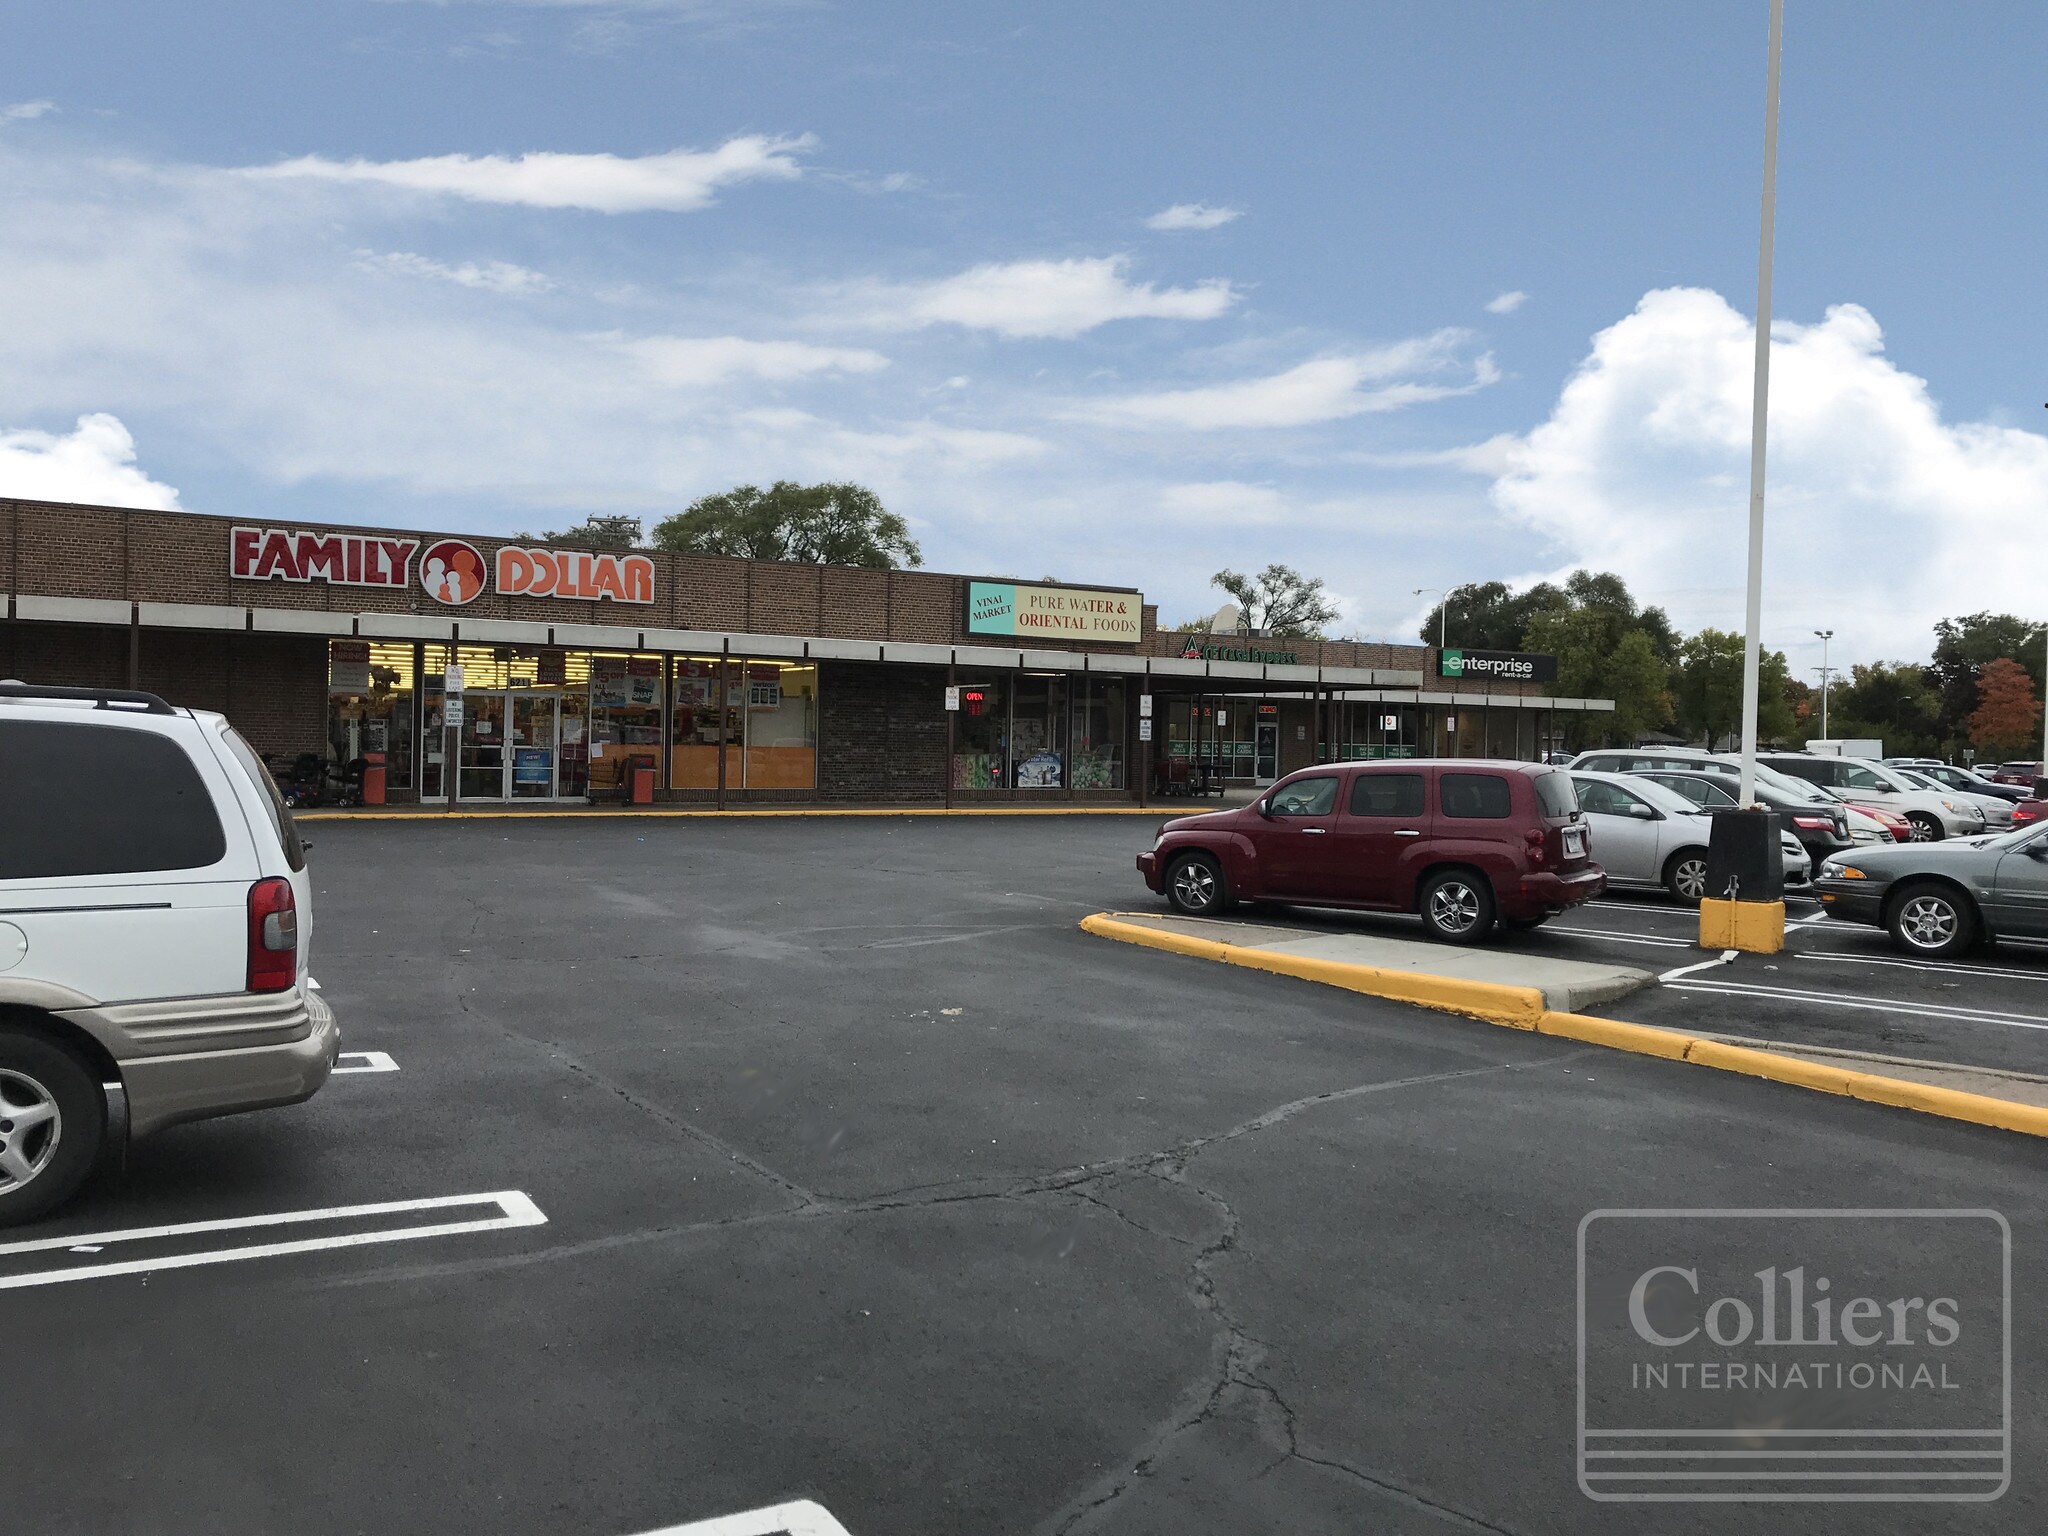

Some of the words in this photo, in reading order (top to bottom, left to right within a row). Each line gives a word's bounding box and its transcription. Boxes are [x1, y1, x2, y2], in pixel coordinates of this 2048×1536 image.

[233, 529, 419, 586] FAMILY
[498, 548, 653, 601] DOLLAR
[976, 594, 1002, 608] VINAI
[1030, 595, 1065, 610] PURE
[1116, 601, 1128, 614] &
[973, 604, 1013, 621] MARKET
[1019, 612, 1088, 630] ORIENTAL
[1093, 618, 1137, 633] FOODS
[338, 643, 362, 651] NOW
[1446, 656, 1533, 675] enterprise
[632, 690, 653, 699] SNAP
[966, 692, 983, 700] OPEN
